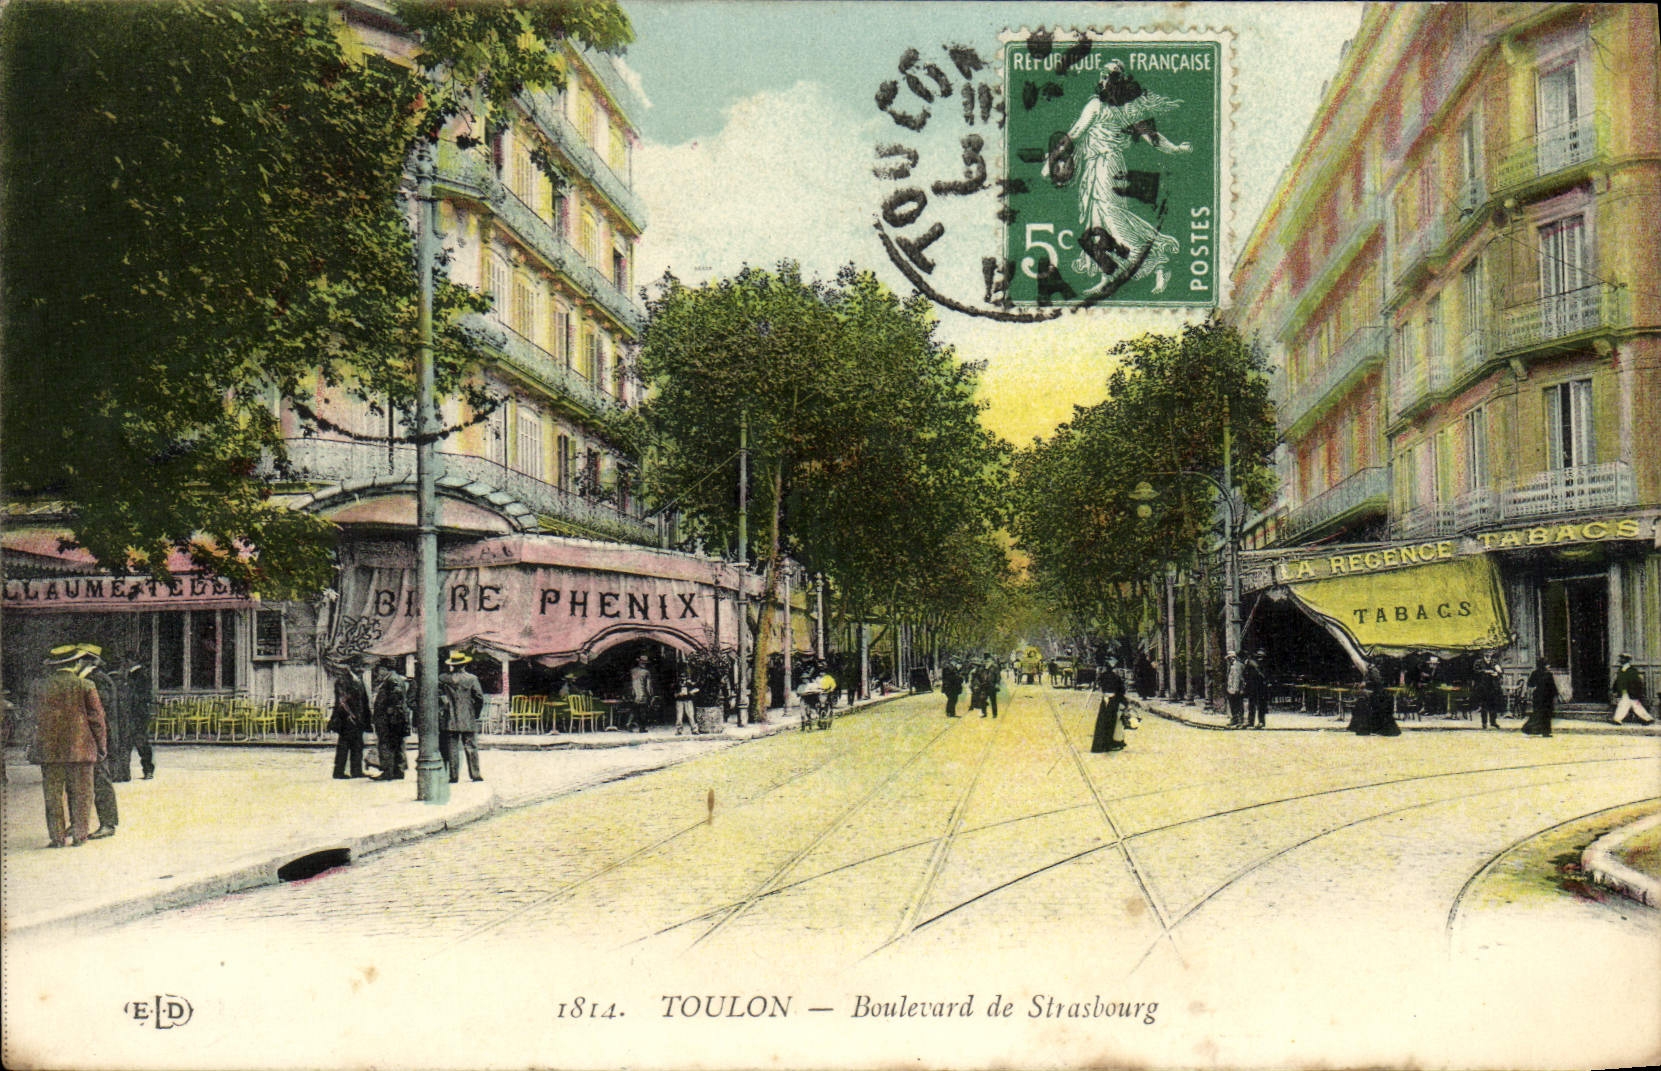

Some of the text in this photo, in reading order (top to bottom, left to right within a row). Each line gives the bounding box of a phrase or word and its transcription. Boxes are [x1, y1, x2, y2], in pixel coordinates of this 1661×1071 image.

[1129, 52, 1211, 73] FRANÇAISE
[1190, 206, 1210, 291] POSTES
[1477, 519, 1641, 549] TABACS
[1280, 560, 1316, 581] LA
[374, 583, 700, 620] BIRE PHENIX
[1353, 601, 1473, 625] TABACS
